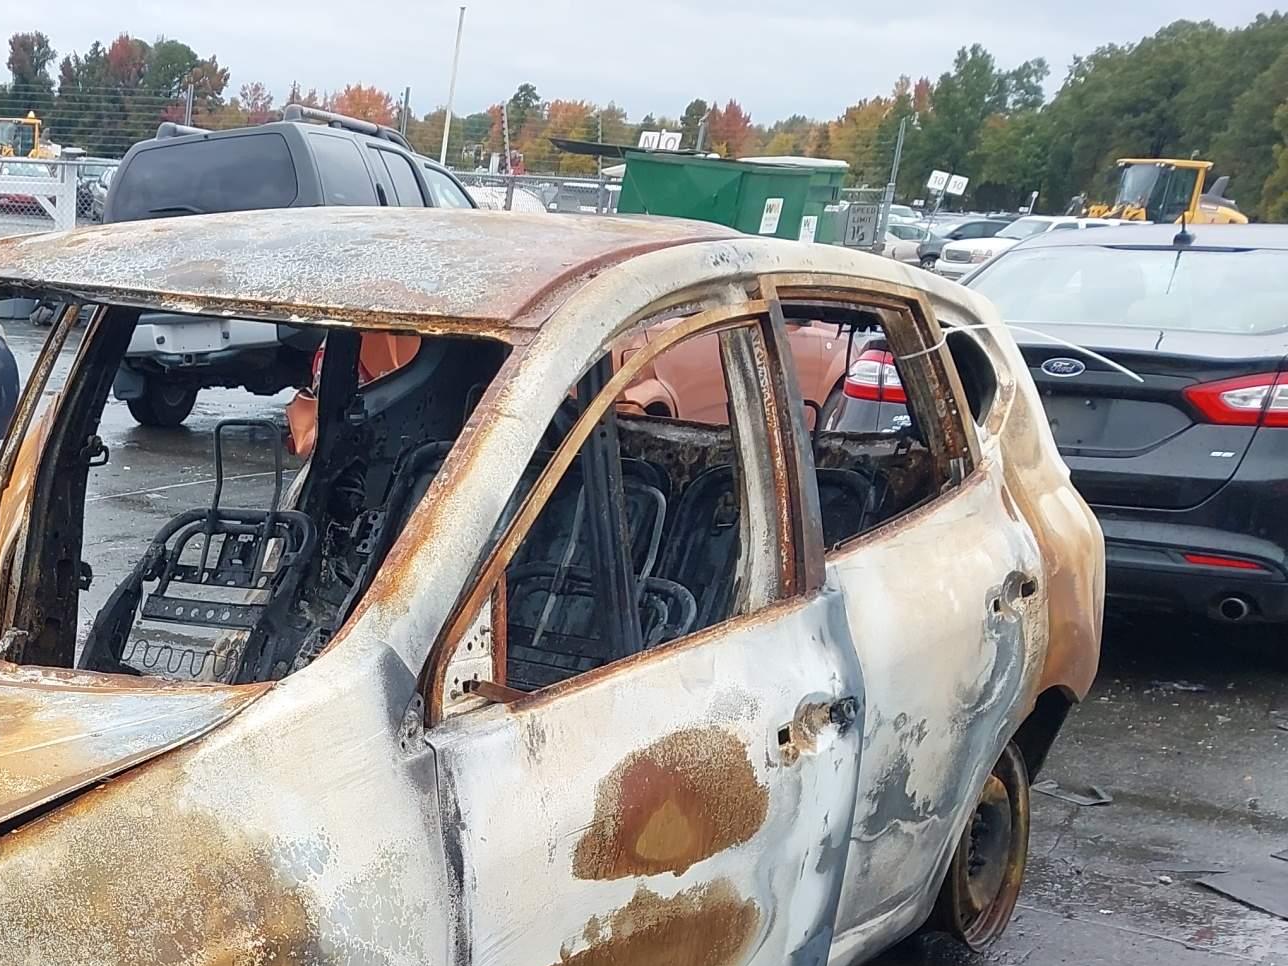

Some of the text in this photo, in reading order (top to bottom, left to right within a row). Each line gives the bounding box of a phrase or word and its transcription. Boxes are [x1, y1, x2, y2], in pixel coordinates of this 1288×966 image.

[933, 175, 945, 185] 10
[952, 180, 964, 190] 10
[851, 225, 865, 241] 15
